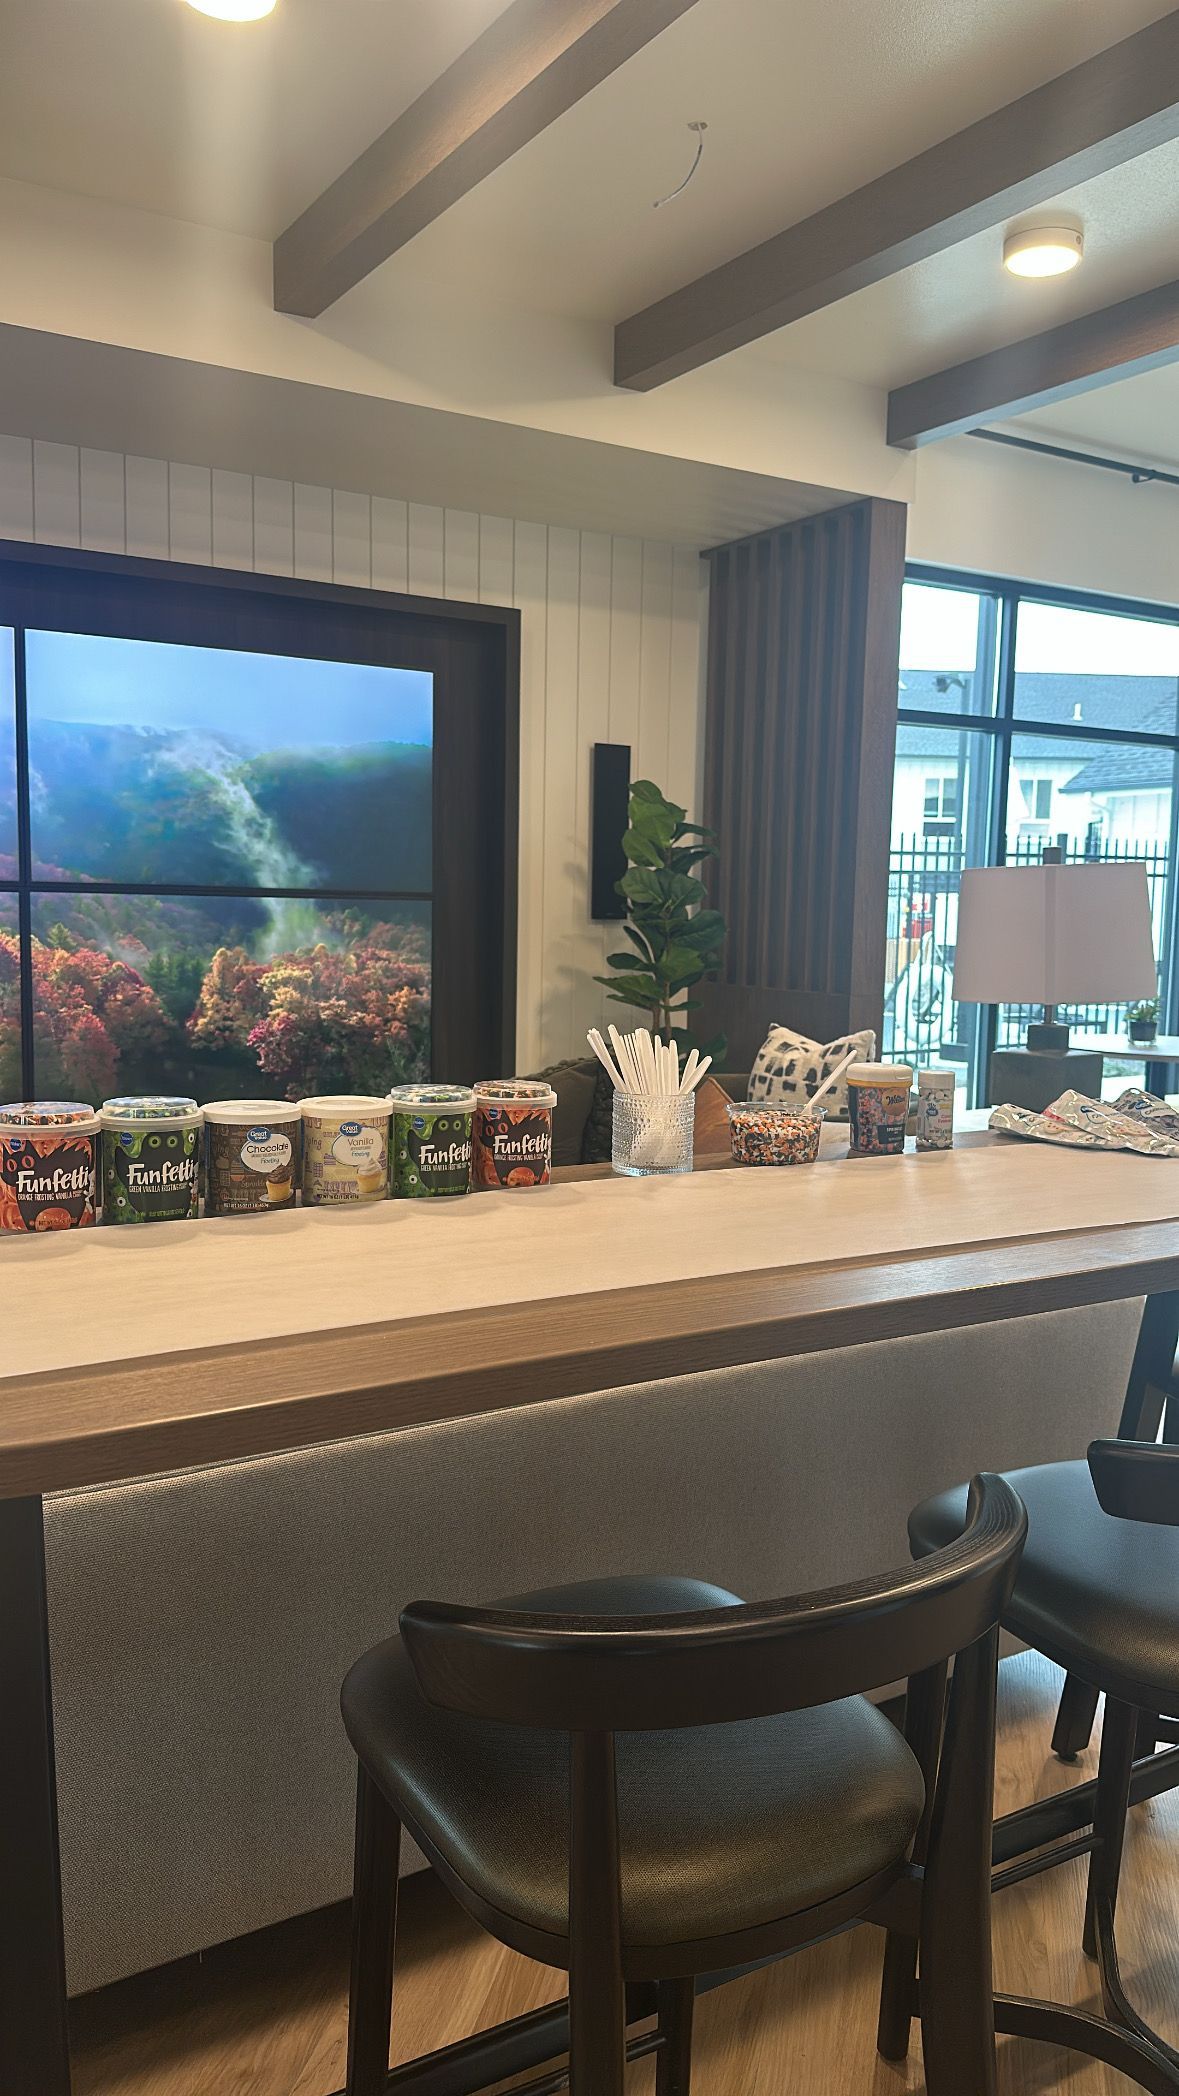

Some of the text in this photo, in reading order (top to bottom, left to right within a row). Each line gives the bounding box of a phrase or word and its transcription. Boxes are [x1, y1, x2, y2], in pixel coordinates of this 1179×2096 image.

[246, 1143, 289, 1154] Chocolate
[348, 1138, 374, 1147] Vanilla
[418, 1141, 472, 1165] Funfetti
[493, 1133, 548, 1155] Funfetti
[15, 1165, 89, 1193] Funfetti
[126, 1158, 194, 1185] Funfetti
[142, 1185, 160, 1193] VANILLA
